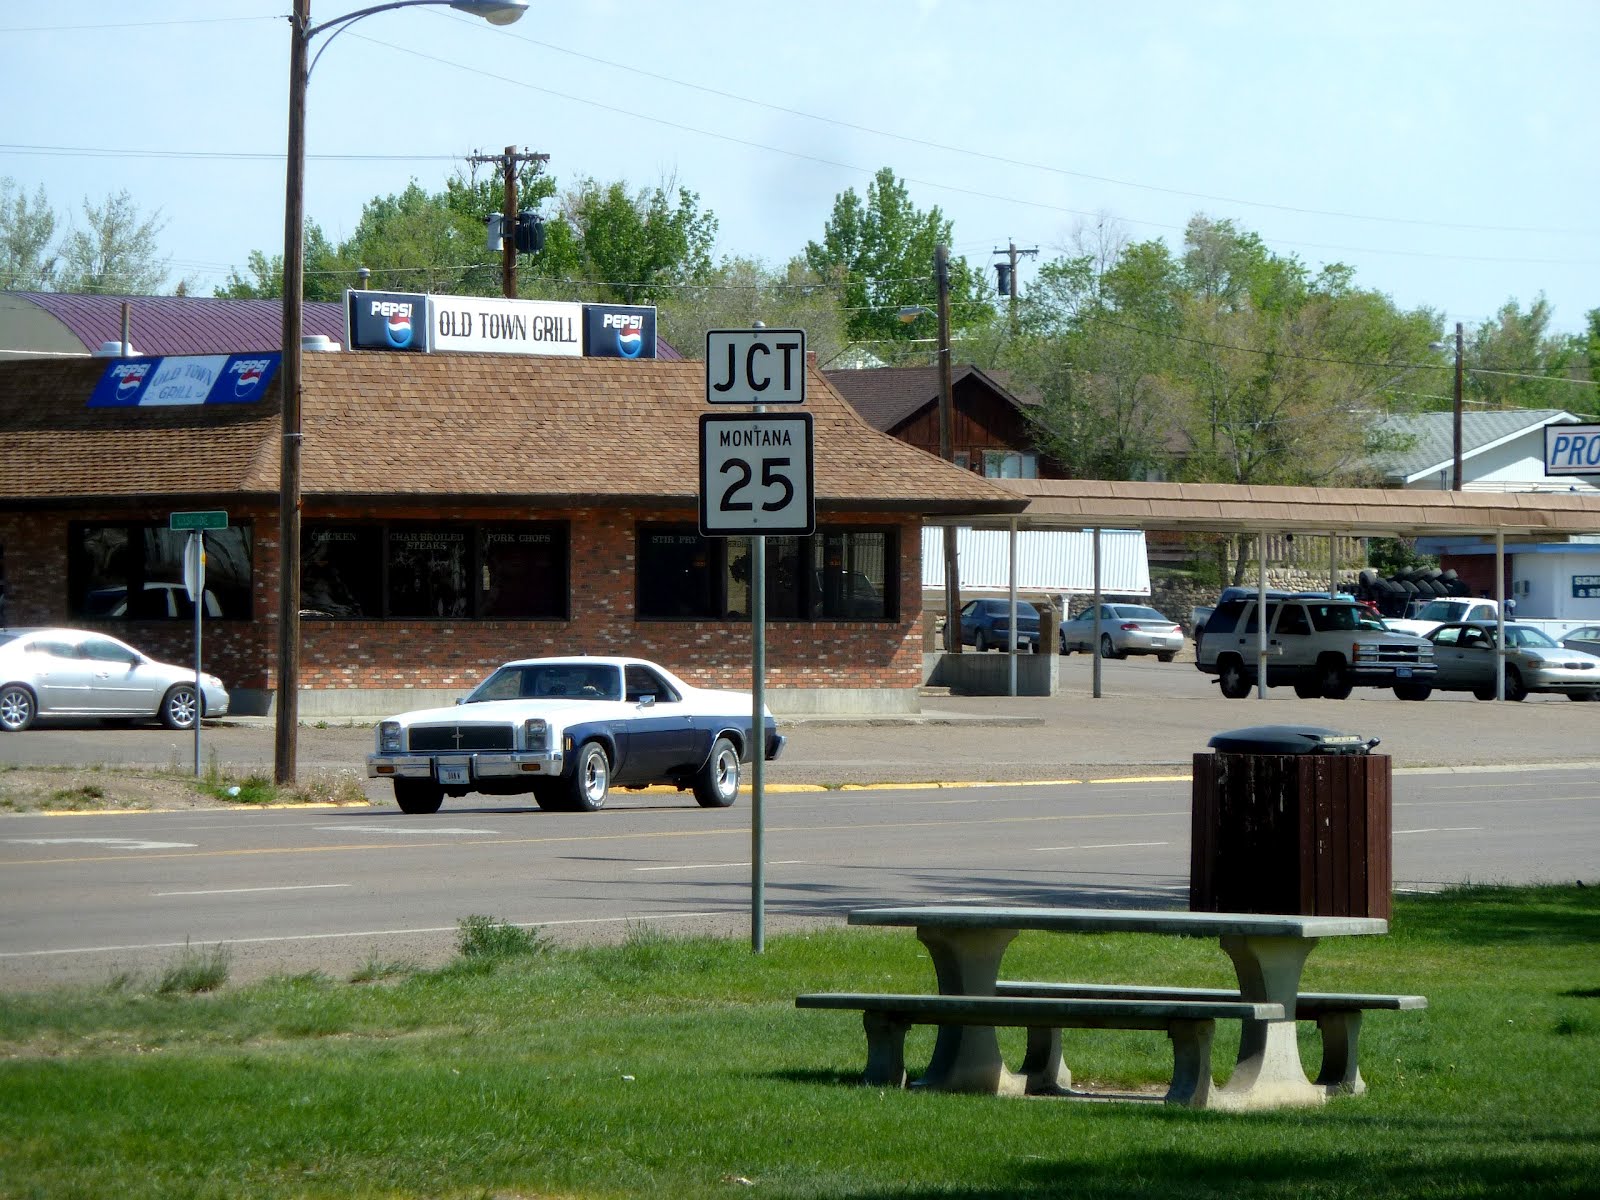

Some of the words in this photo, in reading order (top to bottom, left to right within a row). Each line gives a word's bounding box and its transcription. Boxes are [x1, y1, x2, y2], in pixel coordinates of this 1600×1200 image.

[370, 300, 413, 318] PEPSI
[438, 310, 473, 338] OLD
[478, 312, 528, 341] TOWN
[532, 315, 578, 344] GRILL
[603, 313, 643, 330] PEPSI
[110, 363, 152, 378] PEPSI
[228, 359, 271, 374] PEPSI
[713, 342, 799, 392] JCT
[152, 367, 182, 387] OLD
[184, 364, 213, 386] TOWN
[159, 385, 193, 399] GRILL
[719, 429, 792, 447] MONTANA
[719, 457, 795, 512] 25
[310, 532, 357, 542] CHICKEN
[487, 533, 516, 543] PORK
[518, 533, 552, 543] CHOPS
[651, 535, 675, 545] STIR
[678, 535, 698, 545] FRY
[406, 541, 448, 550] STEAKS
